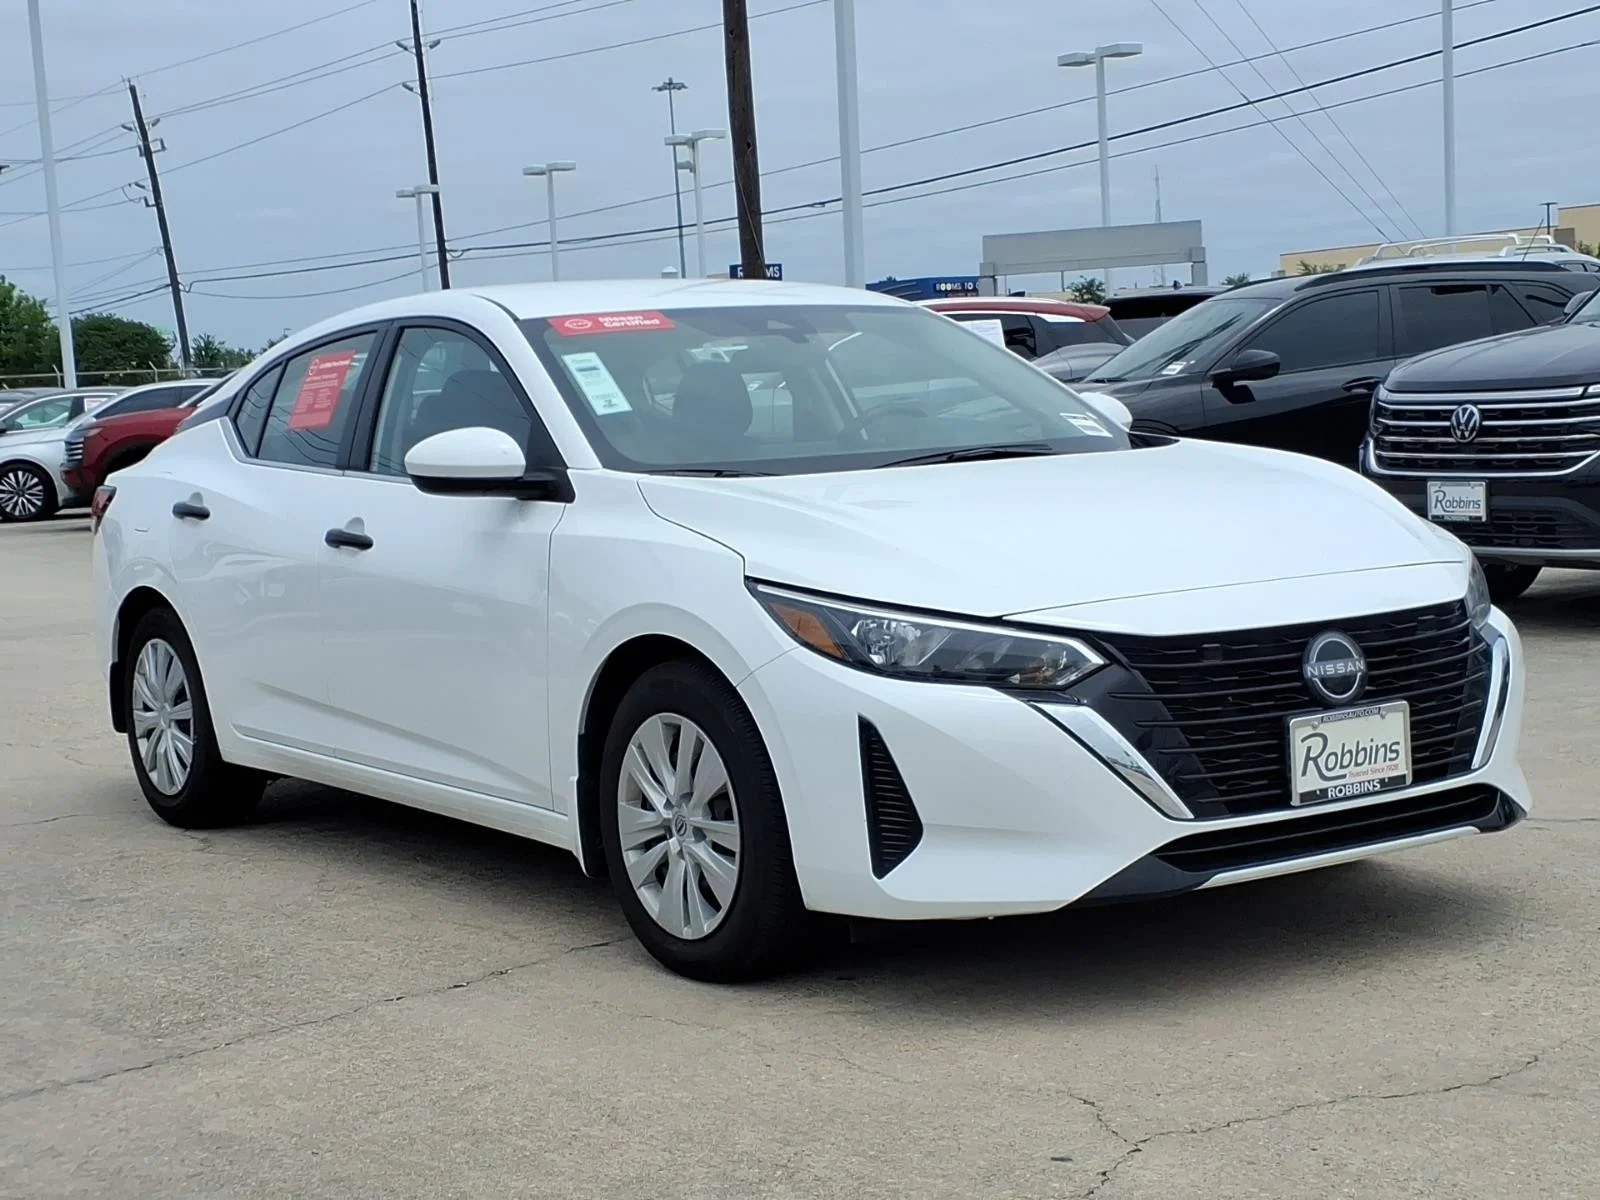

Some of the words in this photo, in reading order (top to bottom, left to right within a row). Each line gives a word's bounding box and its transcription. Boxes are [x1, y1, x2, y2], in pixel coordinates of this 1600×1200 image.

[737, 266, 780, 278] RMS
[1433, 489, 1481, 513] Robbins
[1307, 661, 1364, 677] NISSAN
[1300, 732, 1401, 782] Robbins
[1328, 779, 1380, 799] ROBBINS
